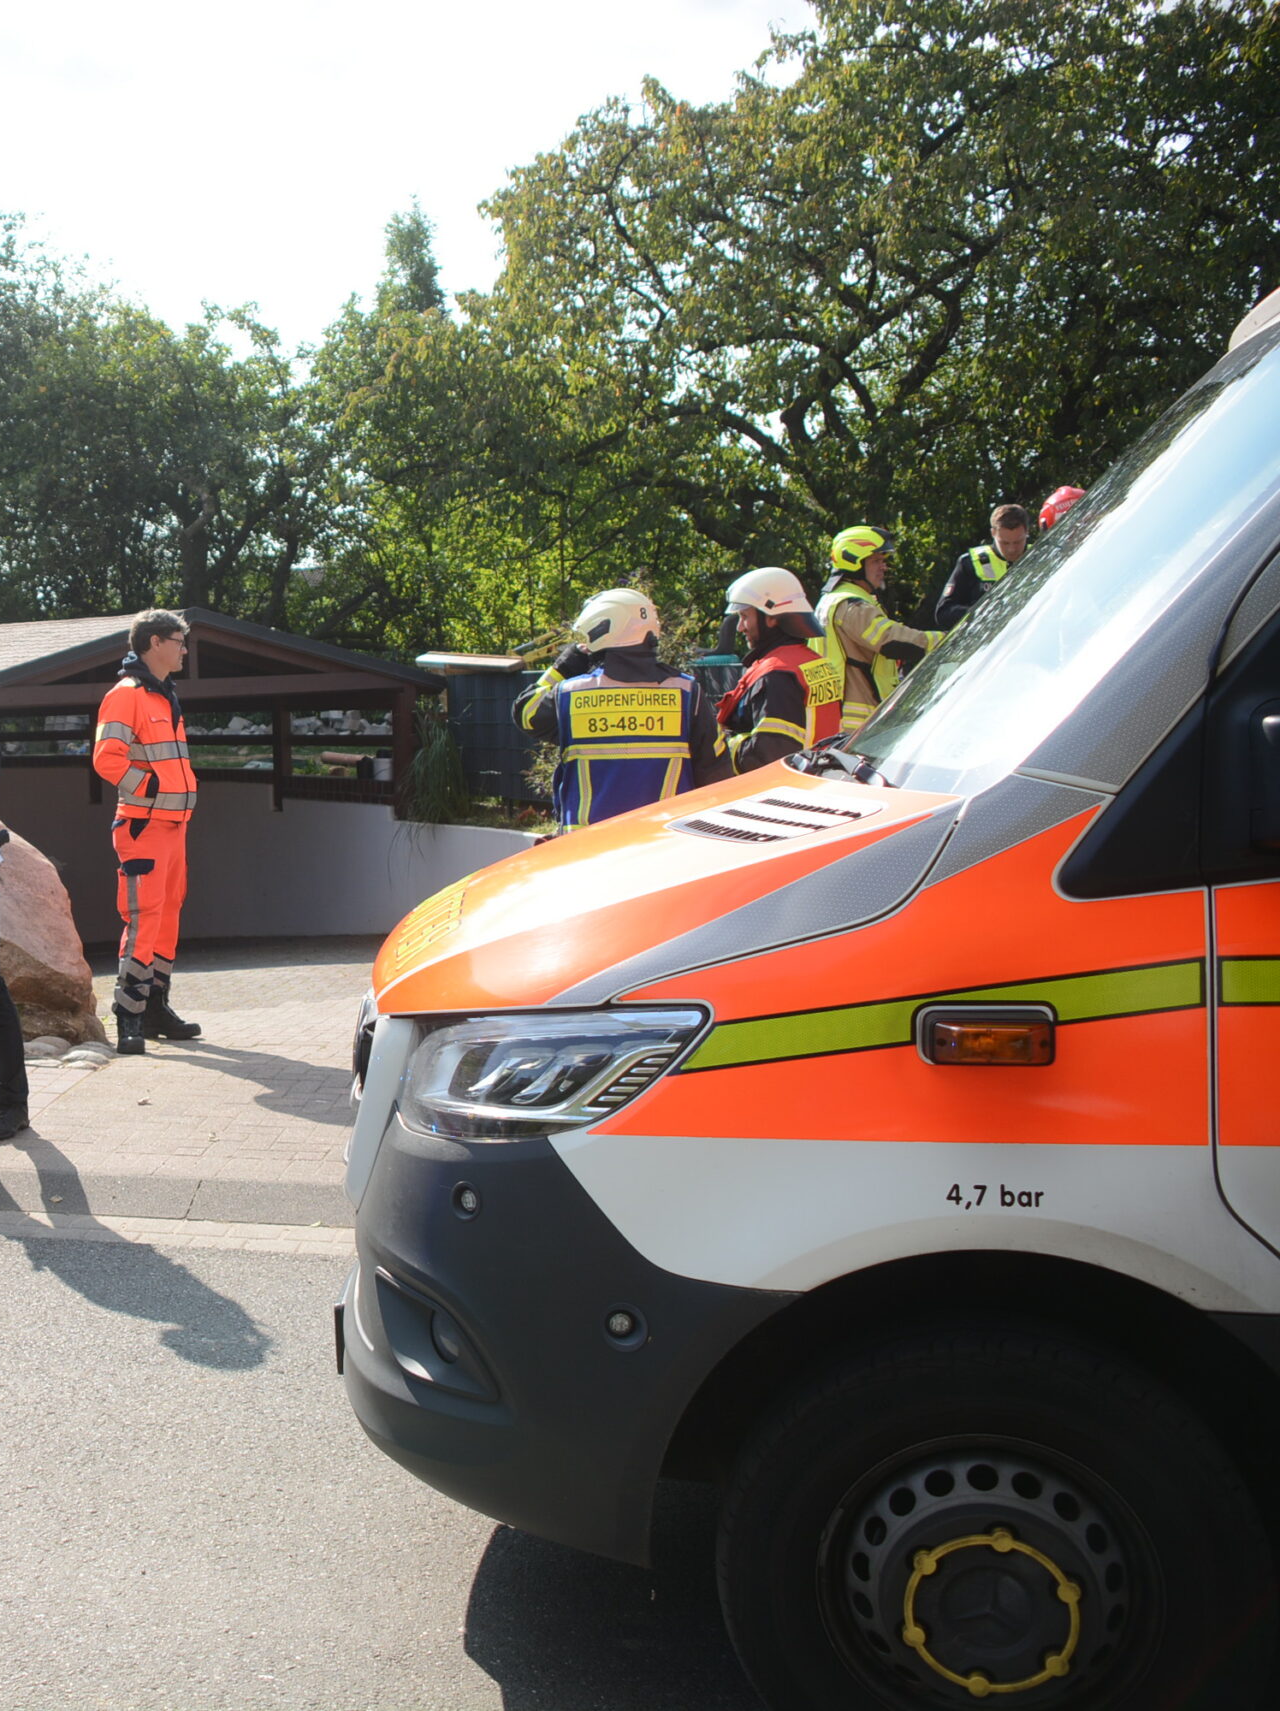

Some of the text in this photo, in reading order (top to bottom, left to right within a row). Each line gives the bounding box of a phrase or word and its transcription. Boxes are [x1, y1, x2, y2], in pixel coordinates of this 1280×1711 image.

[639, 607, 648, 620] 8
[574, 690, 677, 709] GRUPPENFÜHRER
[588, 716, 665, 733] 83-48-01
[946, 1183, 1044, 1210] 4,7 bar
